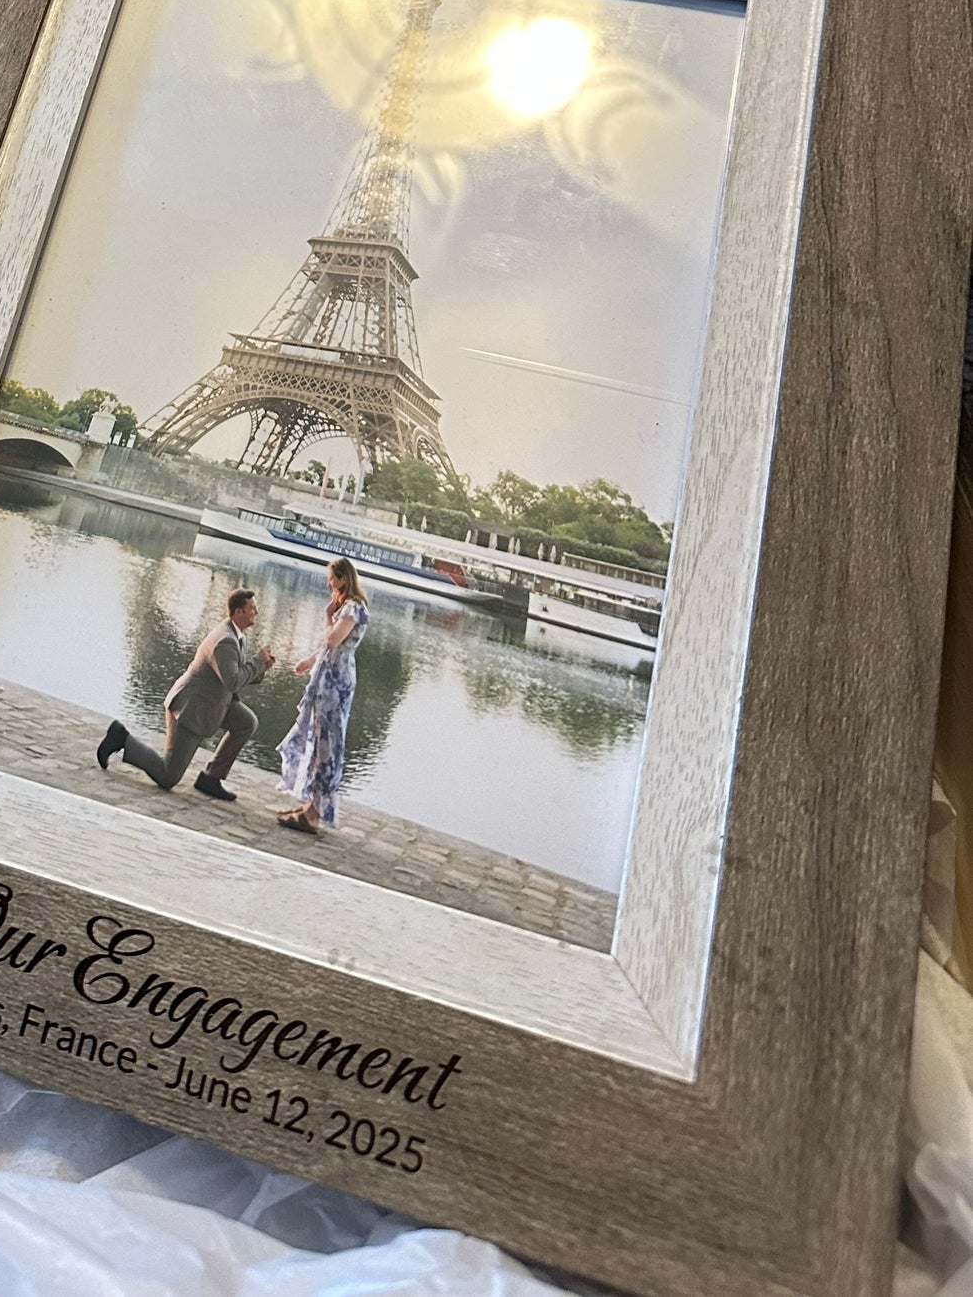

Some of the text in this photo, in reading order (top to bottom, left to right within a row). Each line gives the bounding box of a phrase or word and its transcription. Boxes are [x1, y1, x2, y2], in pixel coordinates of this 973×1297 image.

[19, 1003, 138, 1074] France
[165, 1056, 252, 1114] June
[262, 1088, 315, 1144] 12,
[324, 1109, 426, 1174] 2025
[73, 915, 462, 1111] Engagement
